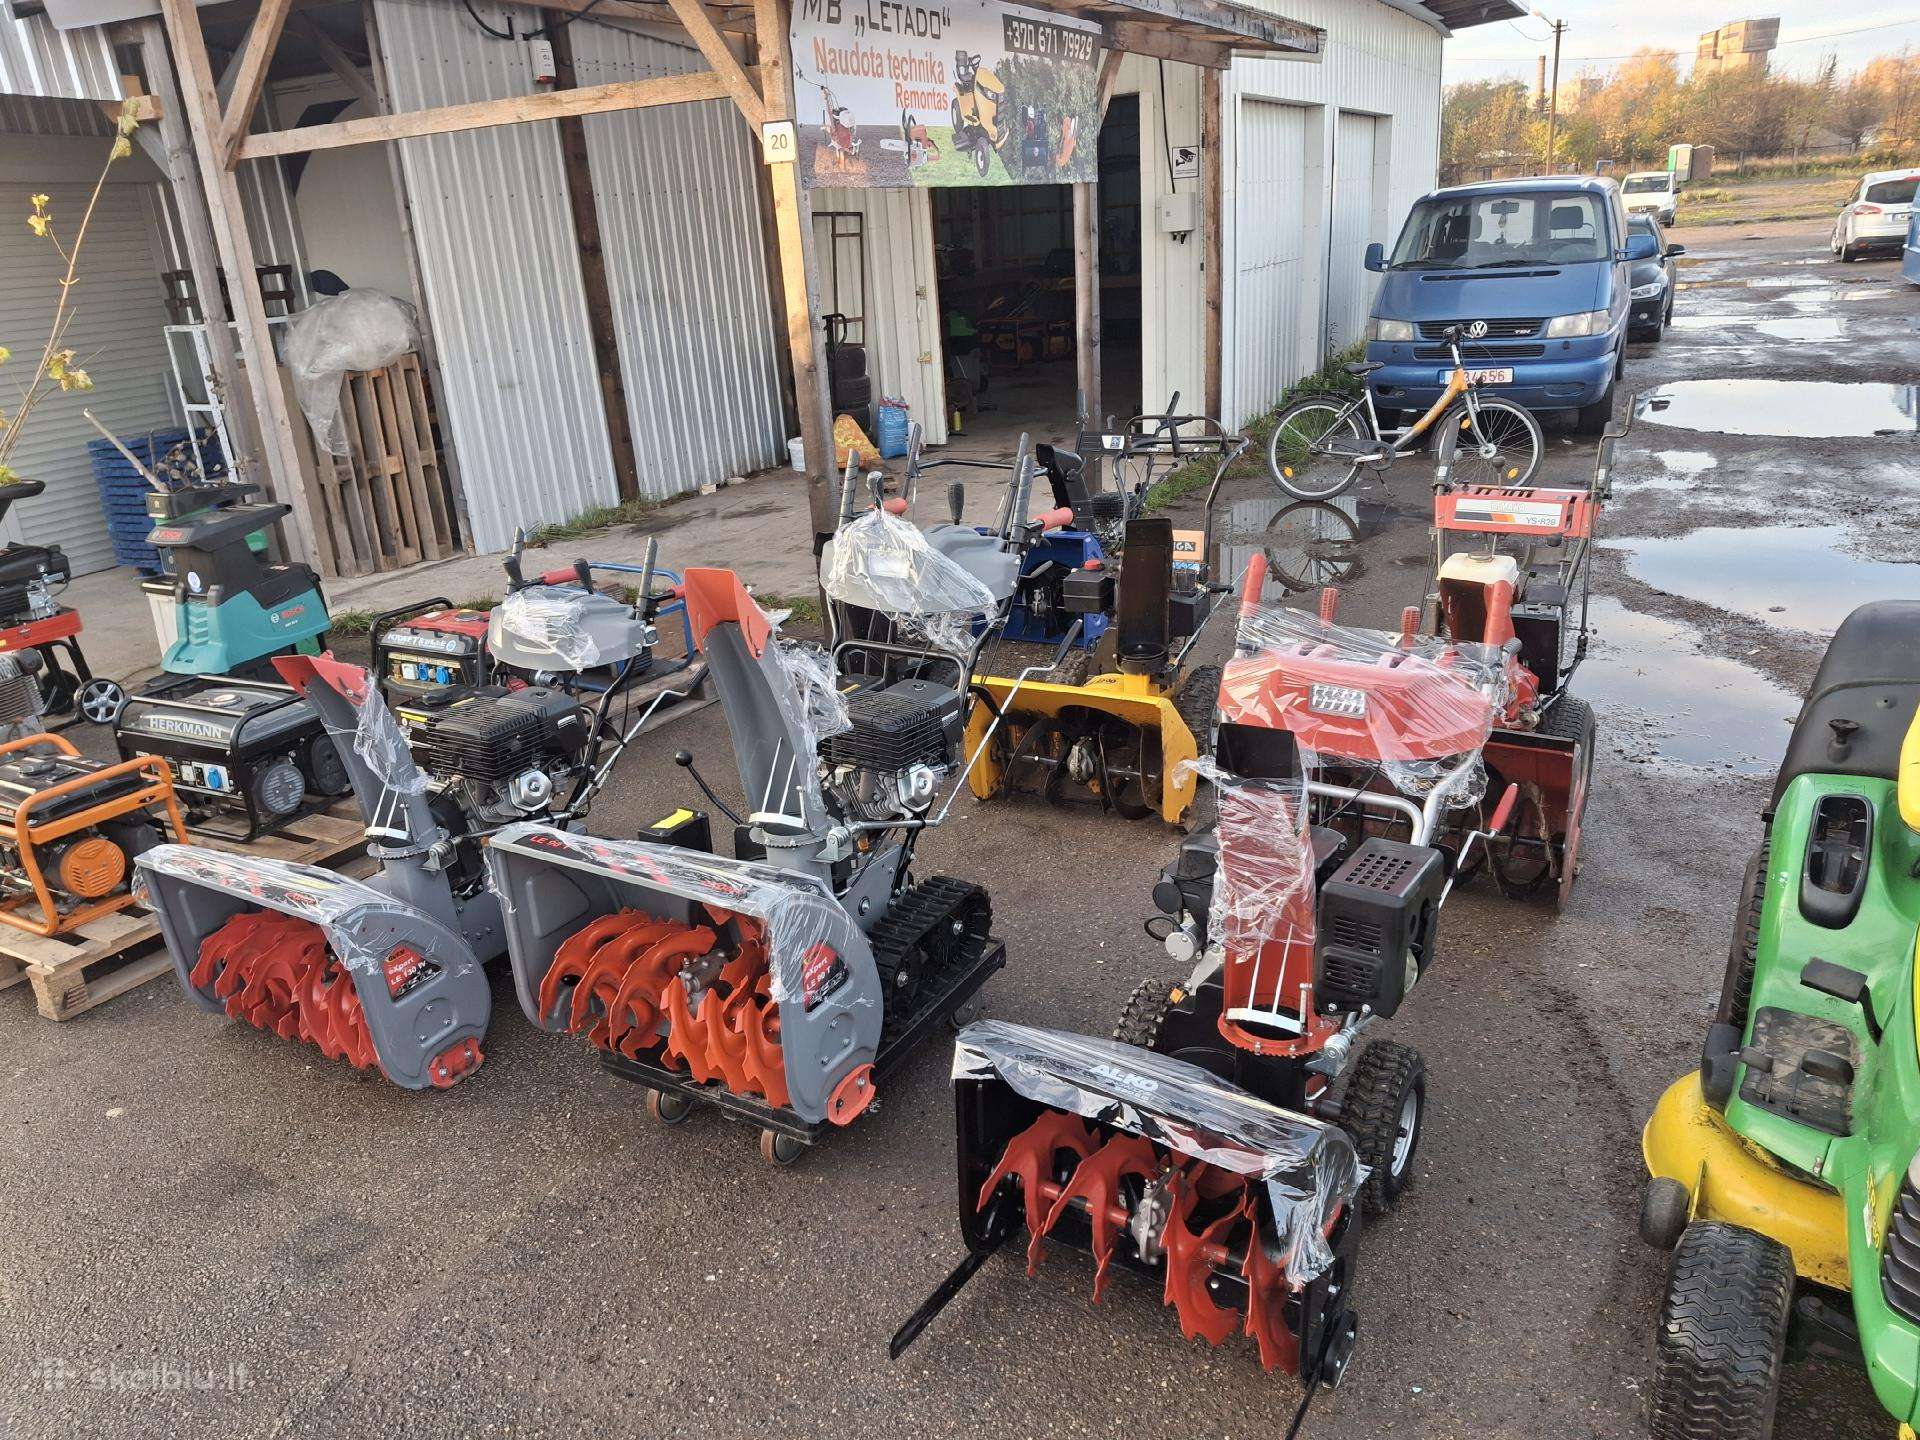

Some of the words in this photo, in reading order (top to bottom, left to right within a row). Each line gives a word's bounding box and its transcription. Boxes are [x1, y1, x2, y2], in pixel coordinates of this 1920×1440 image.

[802, 0, 842, 25] MB
[1007, 21, 1035, 51] +370
[1038, 26, 1058, 55] 671
[1062, 30, 1093, 61] 79929
[812, 37, 884, 79] Naudota
[886, 48, 946, 85] technika
[894, 82, 949, 111] Remontas
[771, 133, 788, 150] 20
[1452, 370, 1505, 383] 34656
[149, 716, 222, 739] HERKMANN
